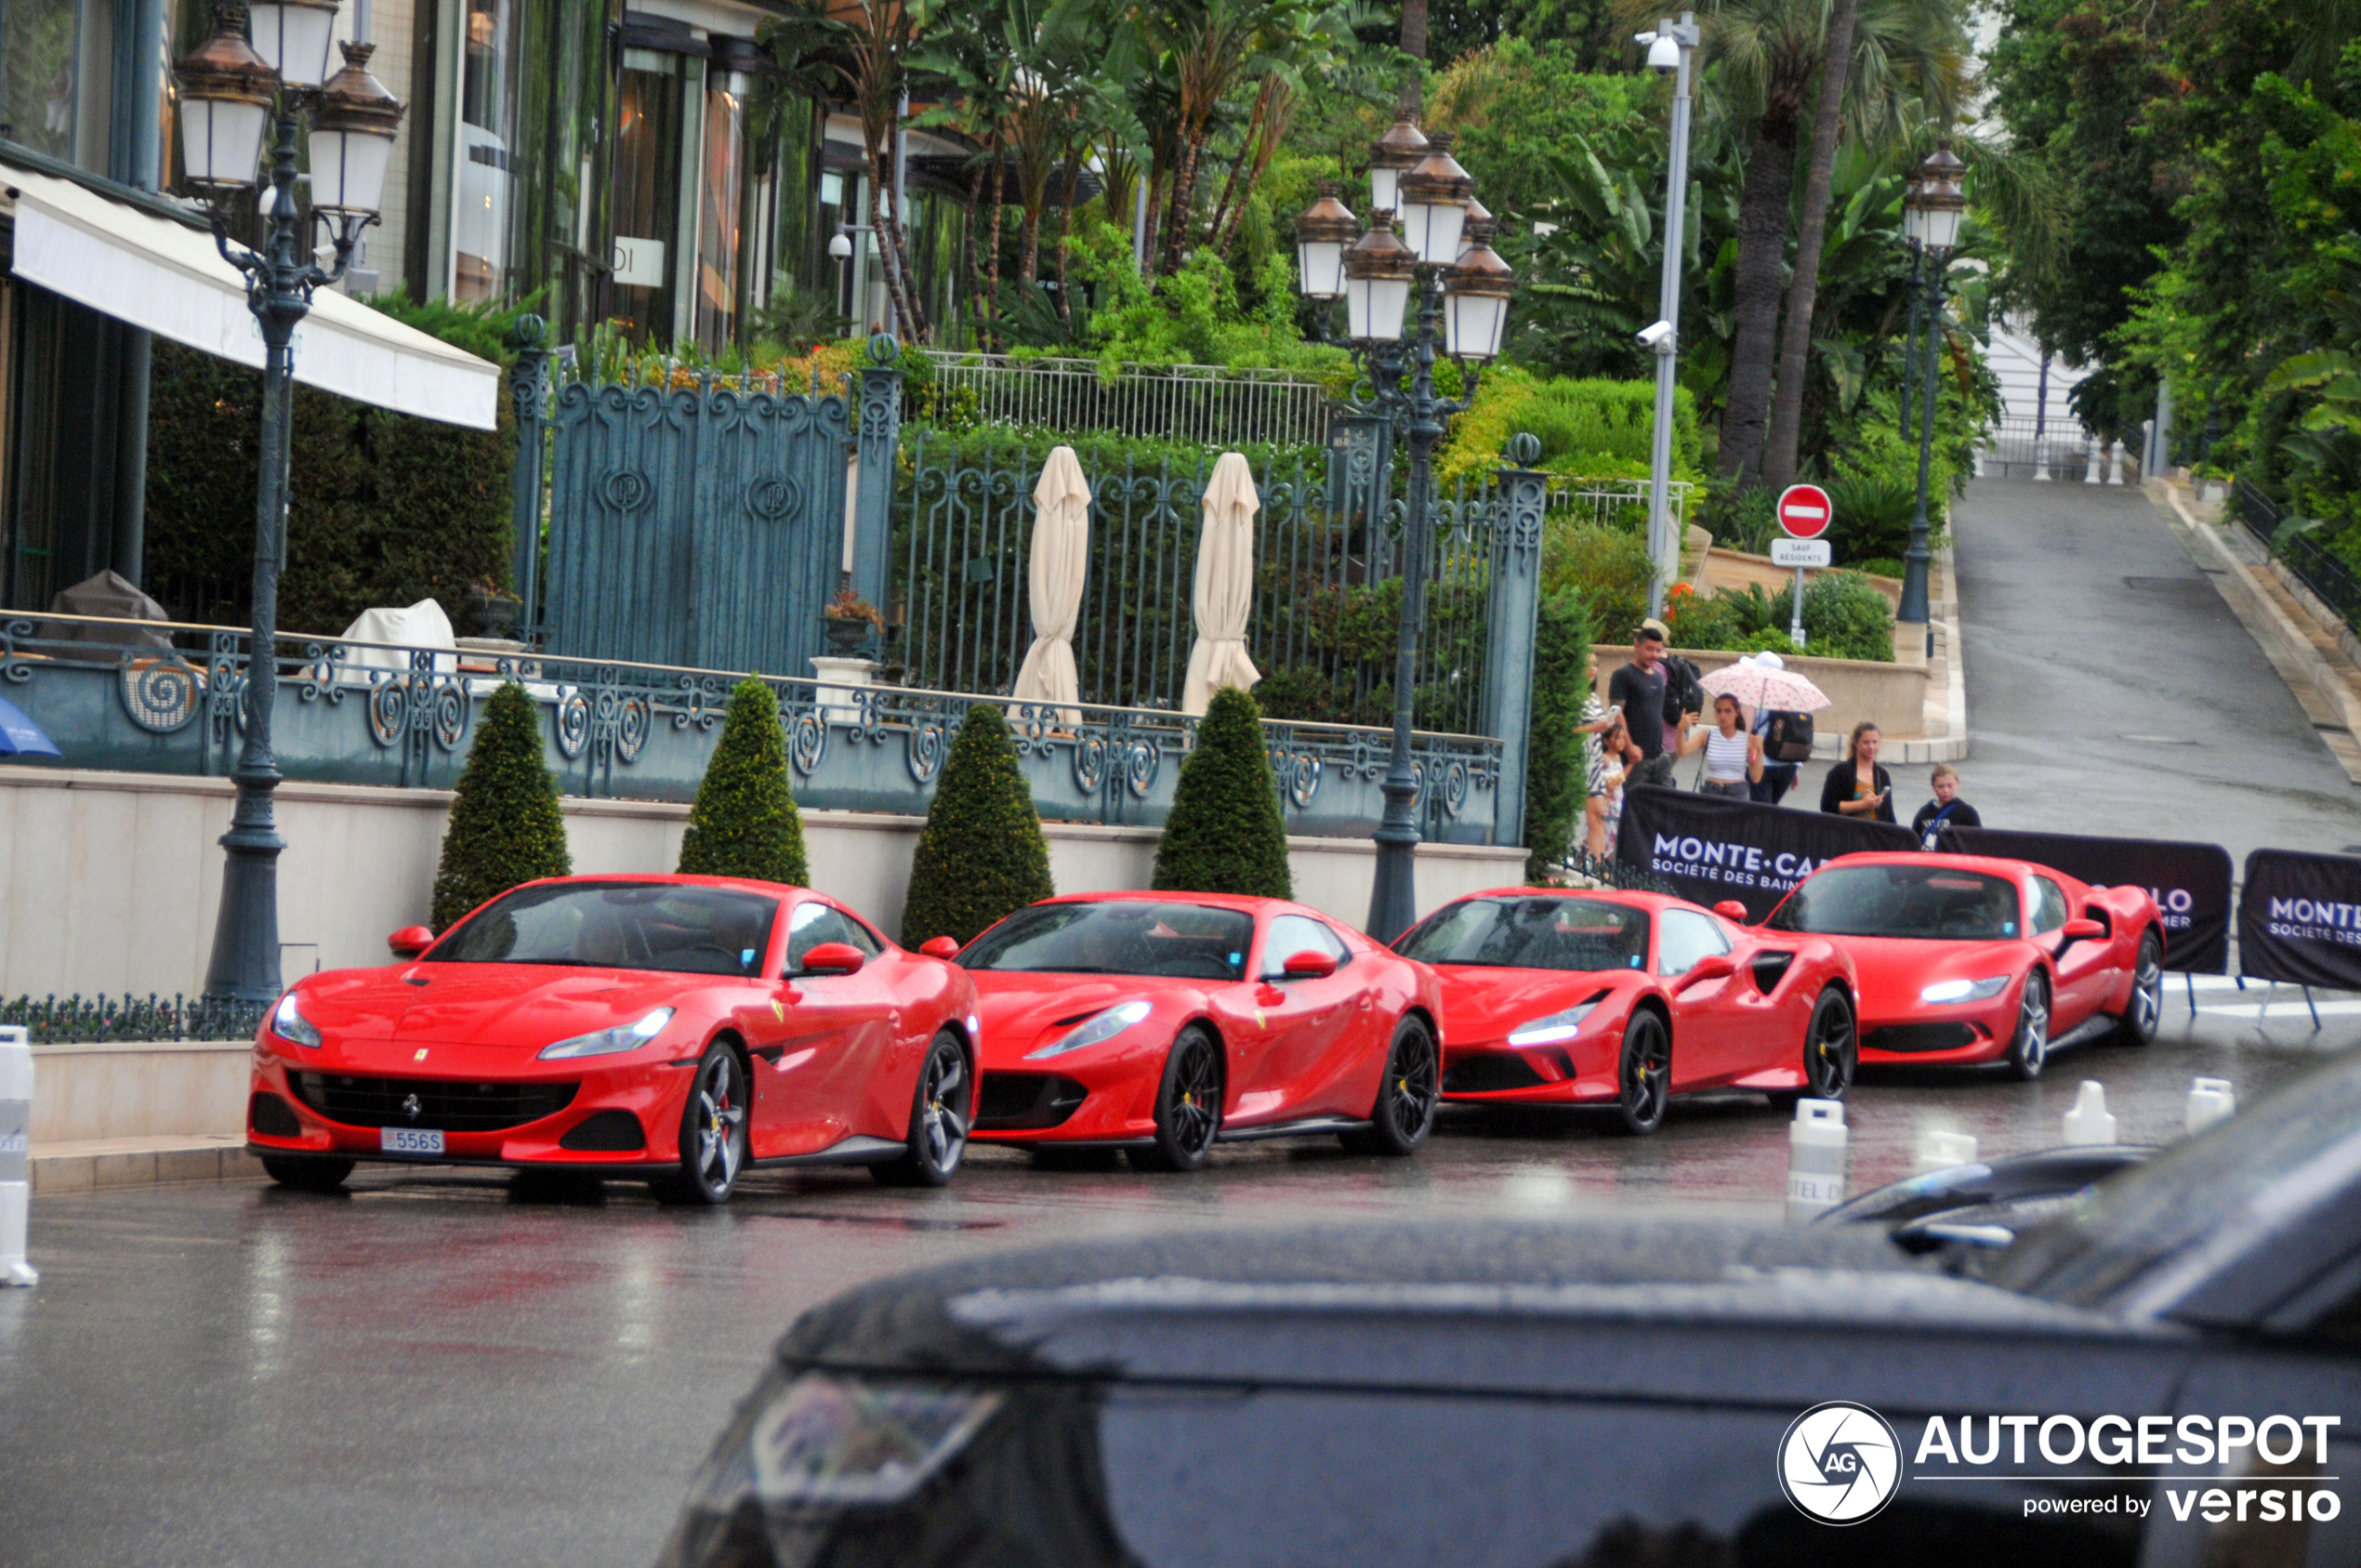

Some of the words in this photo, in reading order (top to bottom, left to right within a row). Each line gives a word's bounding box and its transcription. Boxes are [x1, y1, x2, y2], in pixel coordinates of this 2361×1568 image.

[1779, 552, 1822, 562] RÉSIDENTS
[1652, 858, 1719, 879] SOCIÉTÉ
[1724, 869, 1755, 885] DES
[2270, 922, 2331, 941] SOCIÉTÉ
[396, 1132, 441, 1150] 556S
